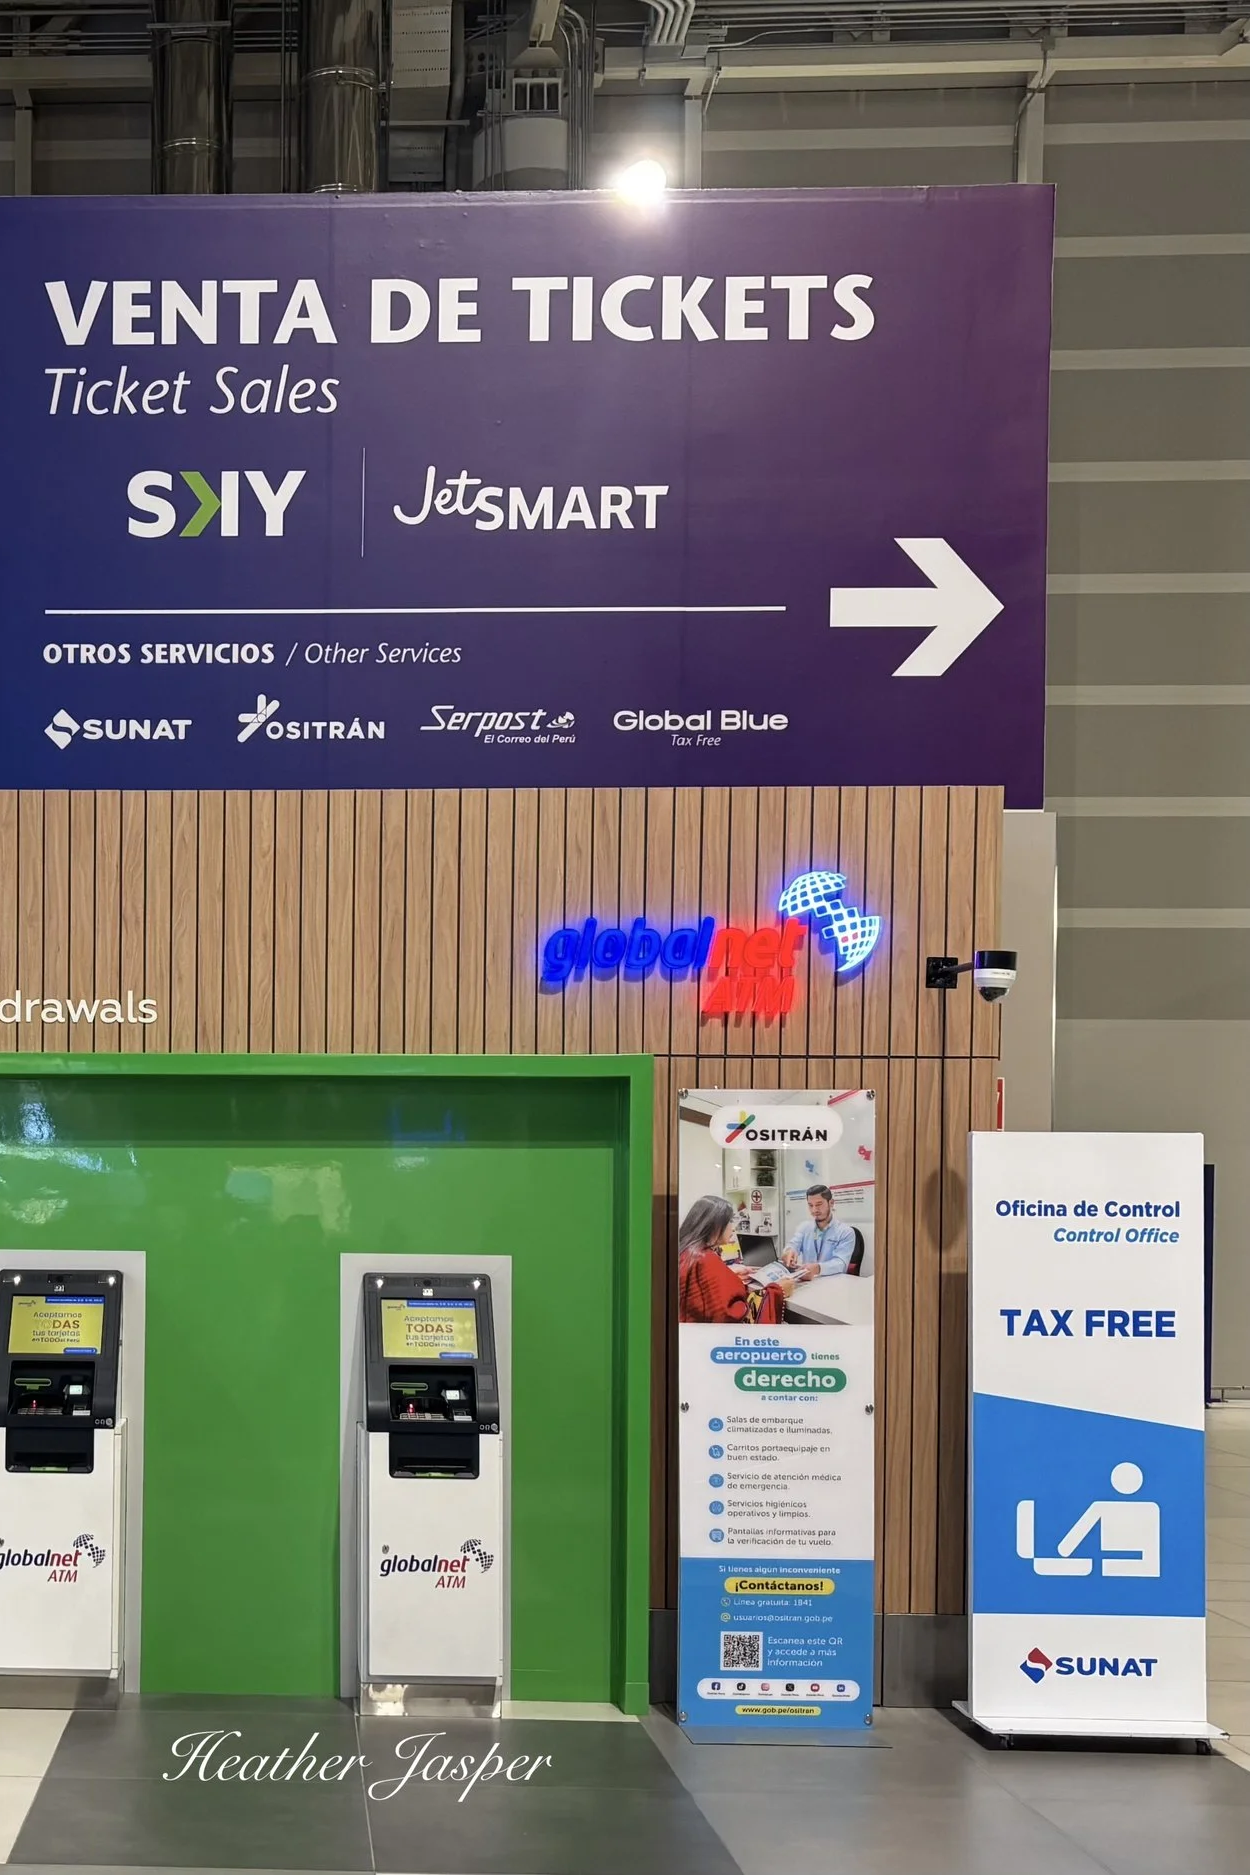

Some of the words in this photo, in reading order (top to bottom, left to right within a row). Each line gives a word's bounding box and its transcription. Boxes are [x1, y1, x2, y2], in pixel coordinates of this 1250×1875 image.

[45, 280, 337, 345] VENTA
[371, 278, 481, 343] DE
[512, 275, 874, 341] TICKETS
[45, 366, 190, 414] Ticket
[210, 365, 339, 413] Sales
[128, 471, 306, 538] SKY
[44, 644, 130, 663] OTROS
[141, 644, 274, 663] SERVICIOS
[305, 643, 369, 663] Other
[376, 643, 461, 663] Services
[83, 719, 192, 739] SUNAT
[266, 716, 385, 740] OSITRÁN
[420, 705, 546, 736] Serpost
[614, 710, 711, 730] Global
[721, 710, 788, 730] Blue
[696, 734, 721, 746] Free
[543, 915, 807, 982] globalnet
[700, 975, 795, 1014] ATM
[745, 1126, 827, 1141] OSITRÁN
[996, 1200, 1066, 1216] Oficina
[1074, 1201, 1098, 1216] de
[1105, 1201, 1179, 1217] Control
[1054, 1228, 1121, 1242] Control
[1126, 1228, 1179, 1243] Office
[1000, 1310, 1073, 1336] TAX
[1086, 1310, 1175, 1337] FREE
[715, 1349, 803, 1363] aeropuerto
[742, 1370, 836, 1388] derecho
[379, 1554, 470, 1577] globalnet
[47, 1569, 78, 1583] ATM
[435, 1575, 466, 1588] ATM
[735, 1580, 824, 1592] ¡Contáctanos!
[1056, 1657, 1157, 1676] SUNAT
